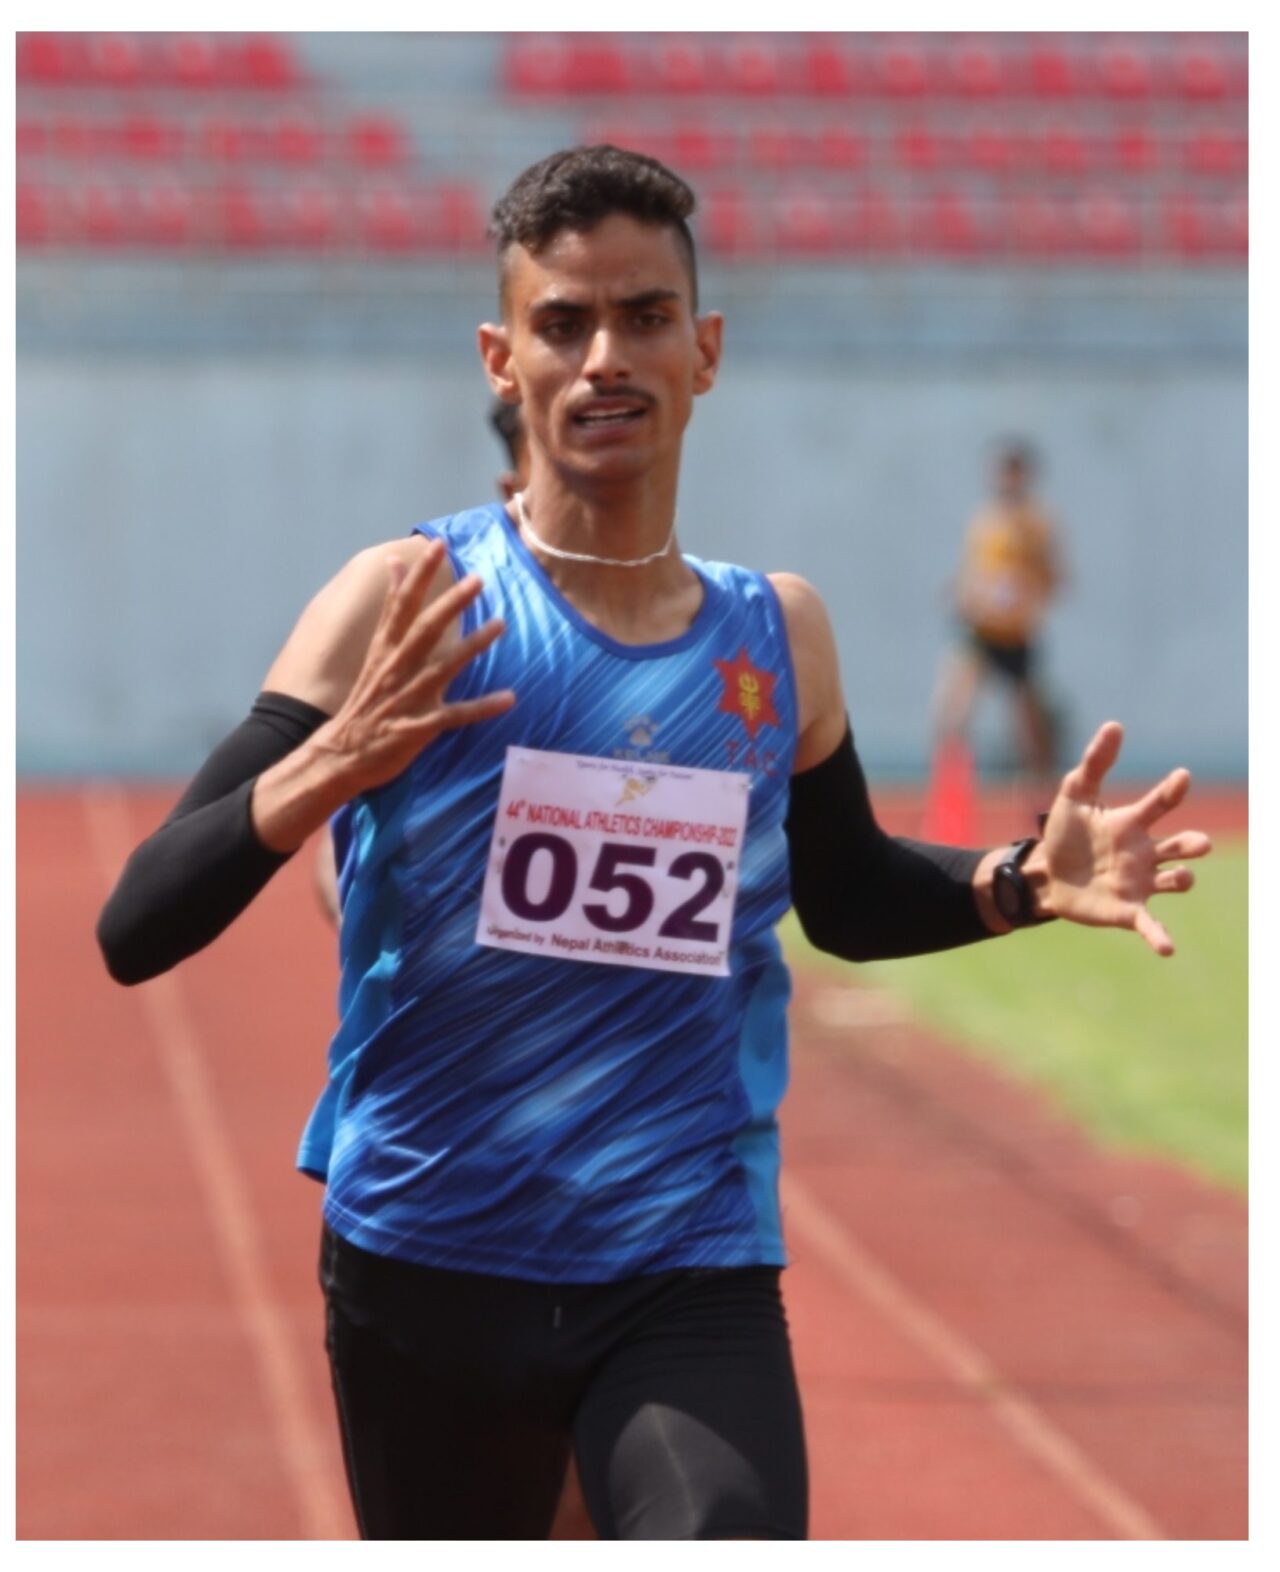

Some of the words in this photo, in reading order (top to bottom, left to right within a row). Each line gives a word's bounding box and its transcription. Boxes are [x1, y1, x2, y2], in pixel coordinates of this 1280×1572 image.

[526, 803, 582, 829] NATIONAL
[585, 811, 641, 835] ATHLETICS
[501, 832, 725, 943] 052
[551, 932, 590, 952] Nepal
[653, 945, 722, 966] Association
